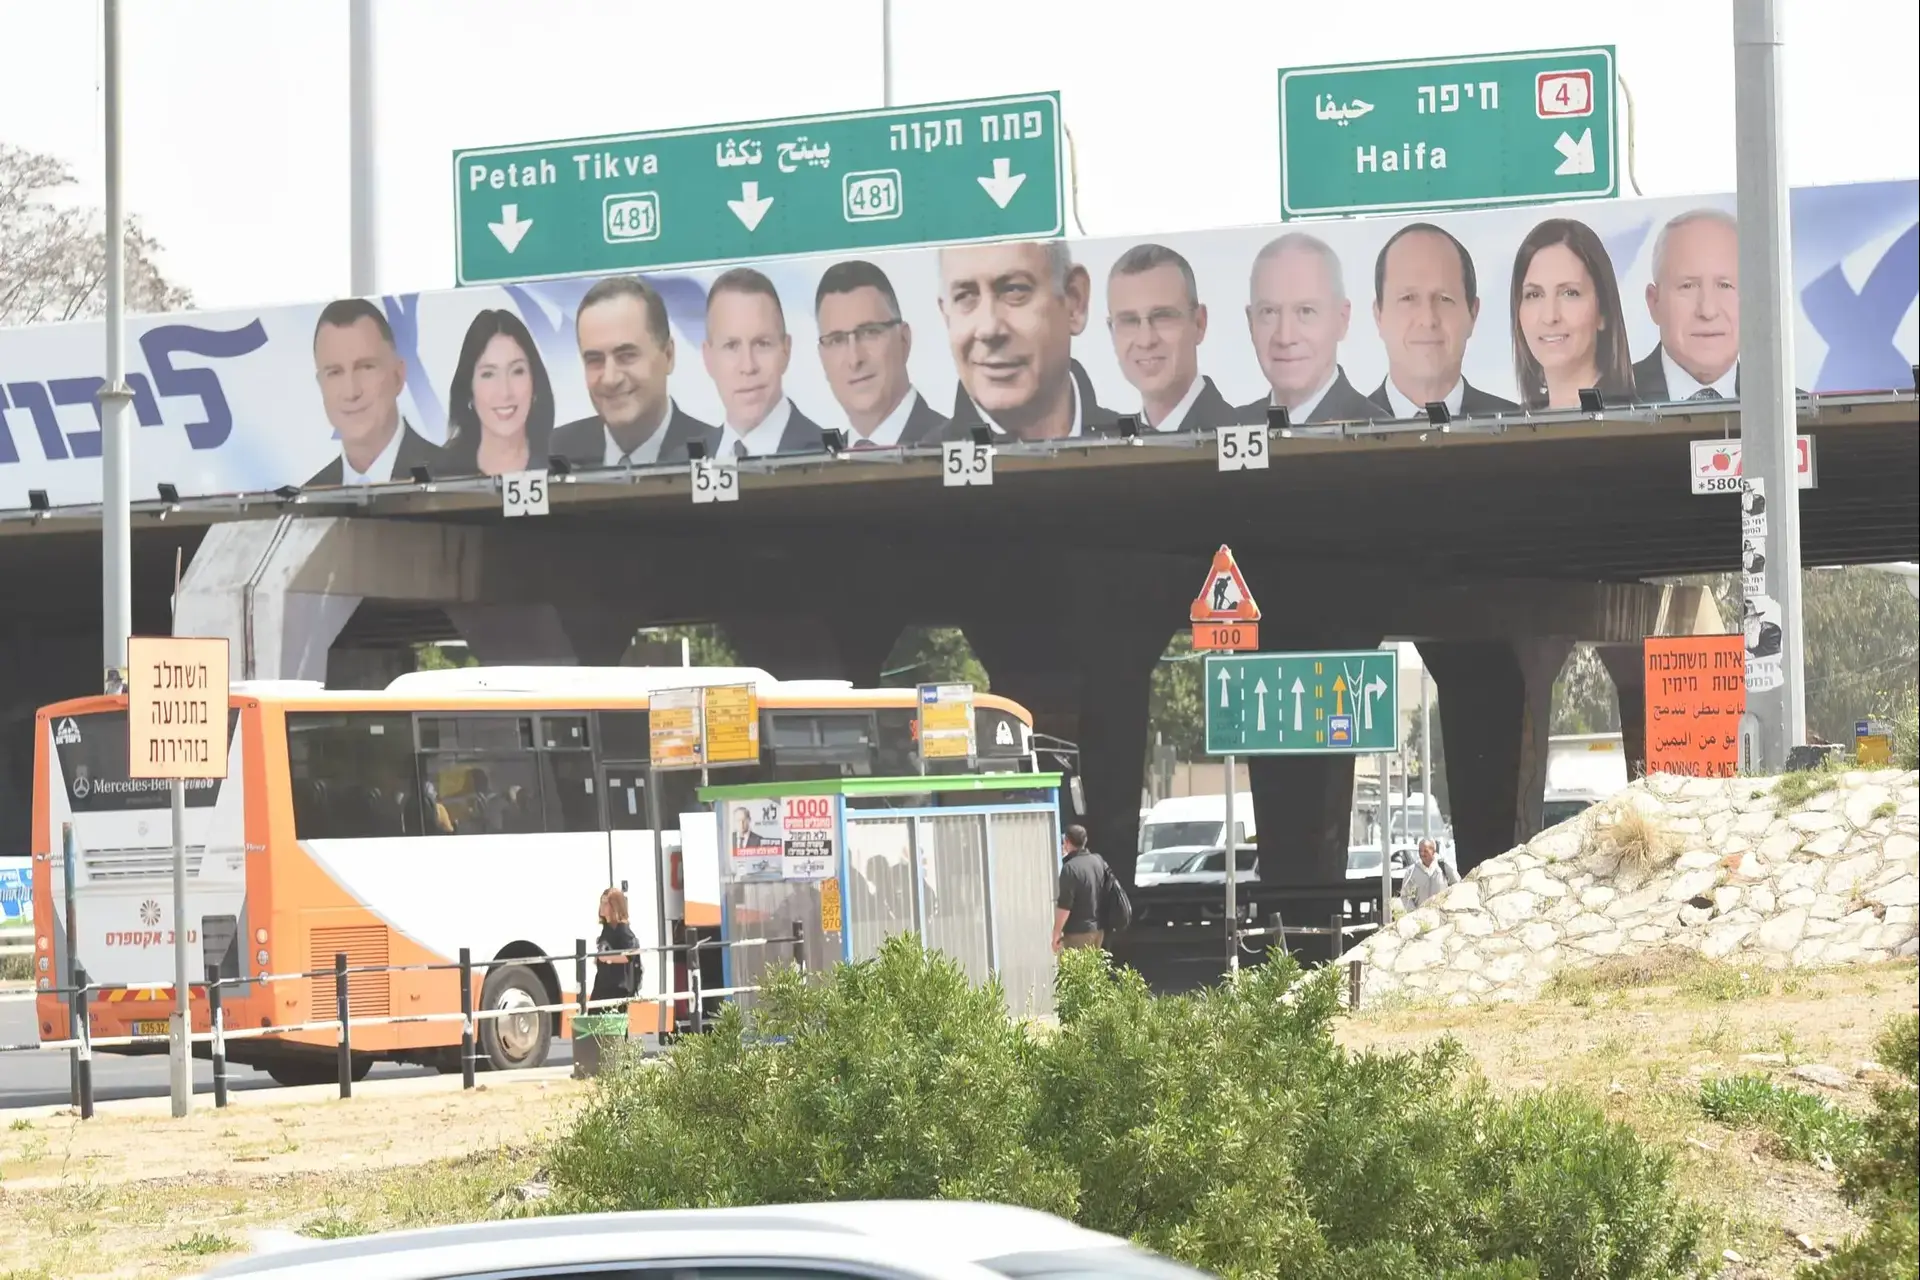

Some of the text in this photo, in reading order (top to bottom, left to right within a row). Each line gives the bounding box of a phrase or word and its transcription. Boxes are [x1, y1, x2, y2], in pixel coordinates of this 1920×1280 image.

[1418, 81, 1498, 114] חיפה
[1555, 83, 1570, 106] 4
[1315, 94, 1375, 126] حيفا
[890, 111, 1043, 152] פתח תקוה
[1357, 142, 1447, 173] Haifa
[470, 152, 658, 191] Petah Tikva
[854, 185, 893, 209] 481
[612, 206, 655, 231] 481
[1222, 431, 1263, 458] 5.5
[948, 448, 988, 474] 5.5
[697, 465, 733, 491] 5.5
[507, 480, 543, 505] 5.5
[1211, 628, 1241, 645] 100
[1649, 651, 1745, 670] איות משתלבות
[152, 662, 208, 689] השתלב
[1662, 675, 1745, 696] יטות מימין
[151, 700, 208, 725] בתנועה
[149, 737, 208, 765] בזהירות
[1699, 734, 1716, 750] من
[93, 779, 172, 794] Mercedes-Ben
[762, 804, 777, 820] לא
[787, 799, 828, 817] 1000
[823, 919, 841, 929] 970
[106, 931, 163, 949] אקספרס
